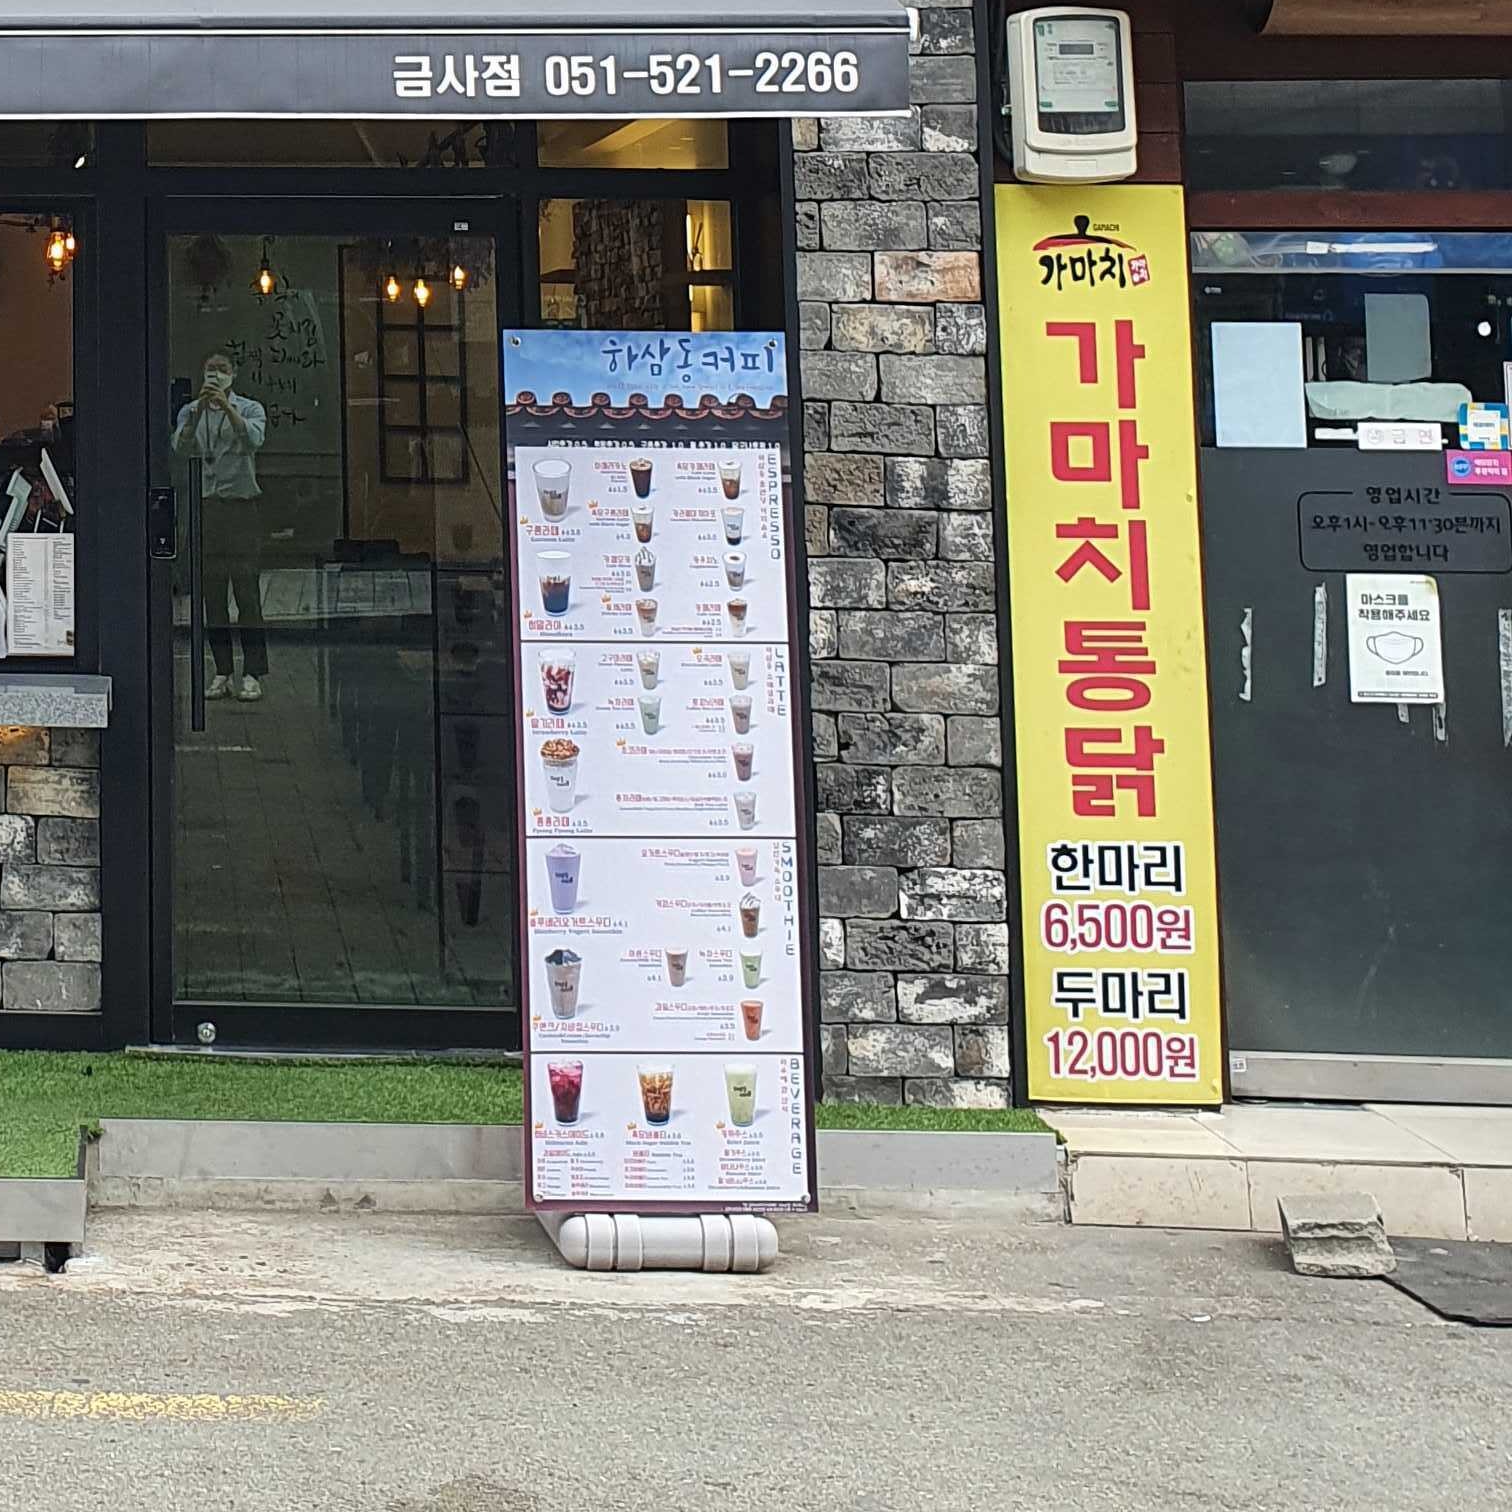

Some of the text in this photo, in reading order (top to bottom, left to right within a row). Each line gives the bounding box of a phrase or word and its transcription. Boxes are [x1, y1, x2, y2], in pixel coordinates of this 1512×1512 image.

[392, 50, 861, 98] 금사점 051-521-2266
[1038, 246, 1126, 291] 가마치
[601, 338, 775, 383] 하삼동 커피
[767, 453, 781, 560] ESPRESSO
[1365, 486, 1441, 505] 영업시간
[1045, 319, 1165, 818] 가마치통닭
[1363, 543, 1449, 562] 영업합니다
[1358, 608, 1431, 621] 착용해주세요
[1360, 593, 1409, 606] 마스크를
[774, 647, 787, 717] LATTE
[1050, 843, 1183, 893] 한마리
[780, 841, 795, 957] SMOOTHIE
[1044, 903, 1192, 950] 6,500원
[1054, 971, 1187, 1020] 두마리
[1046, 1030, 1197, 1079] 12,000원
[789, 1058, 803, 1176] BEVERAGE
